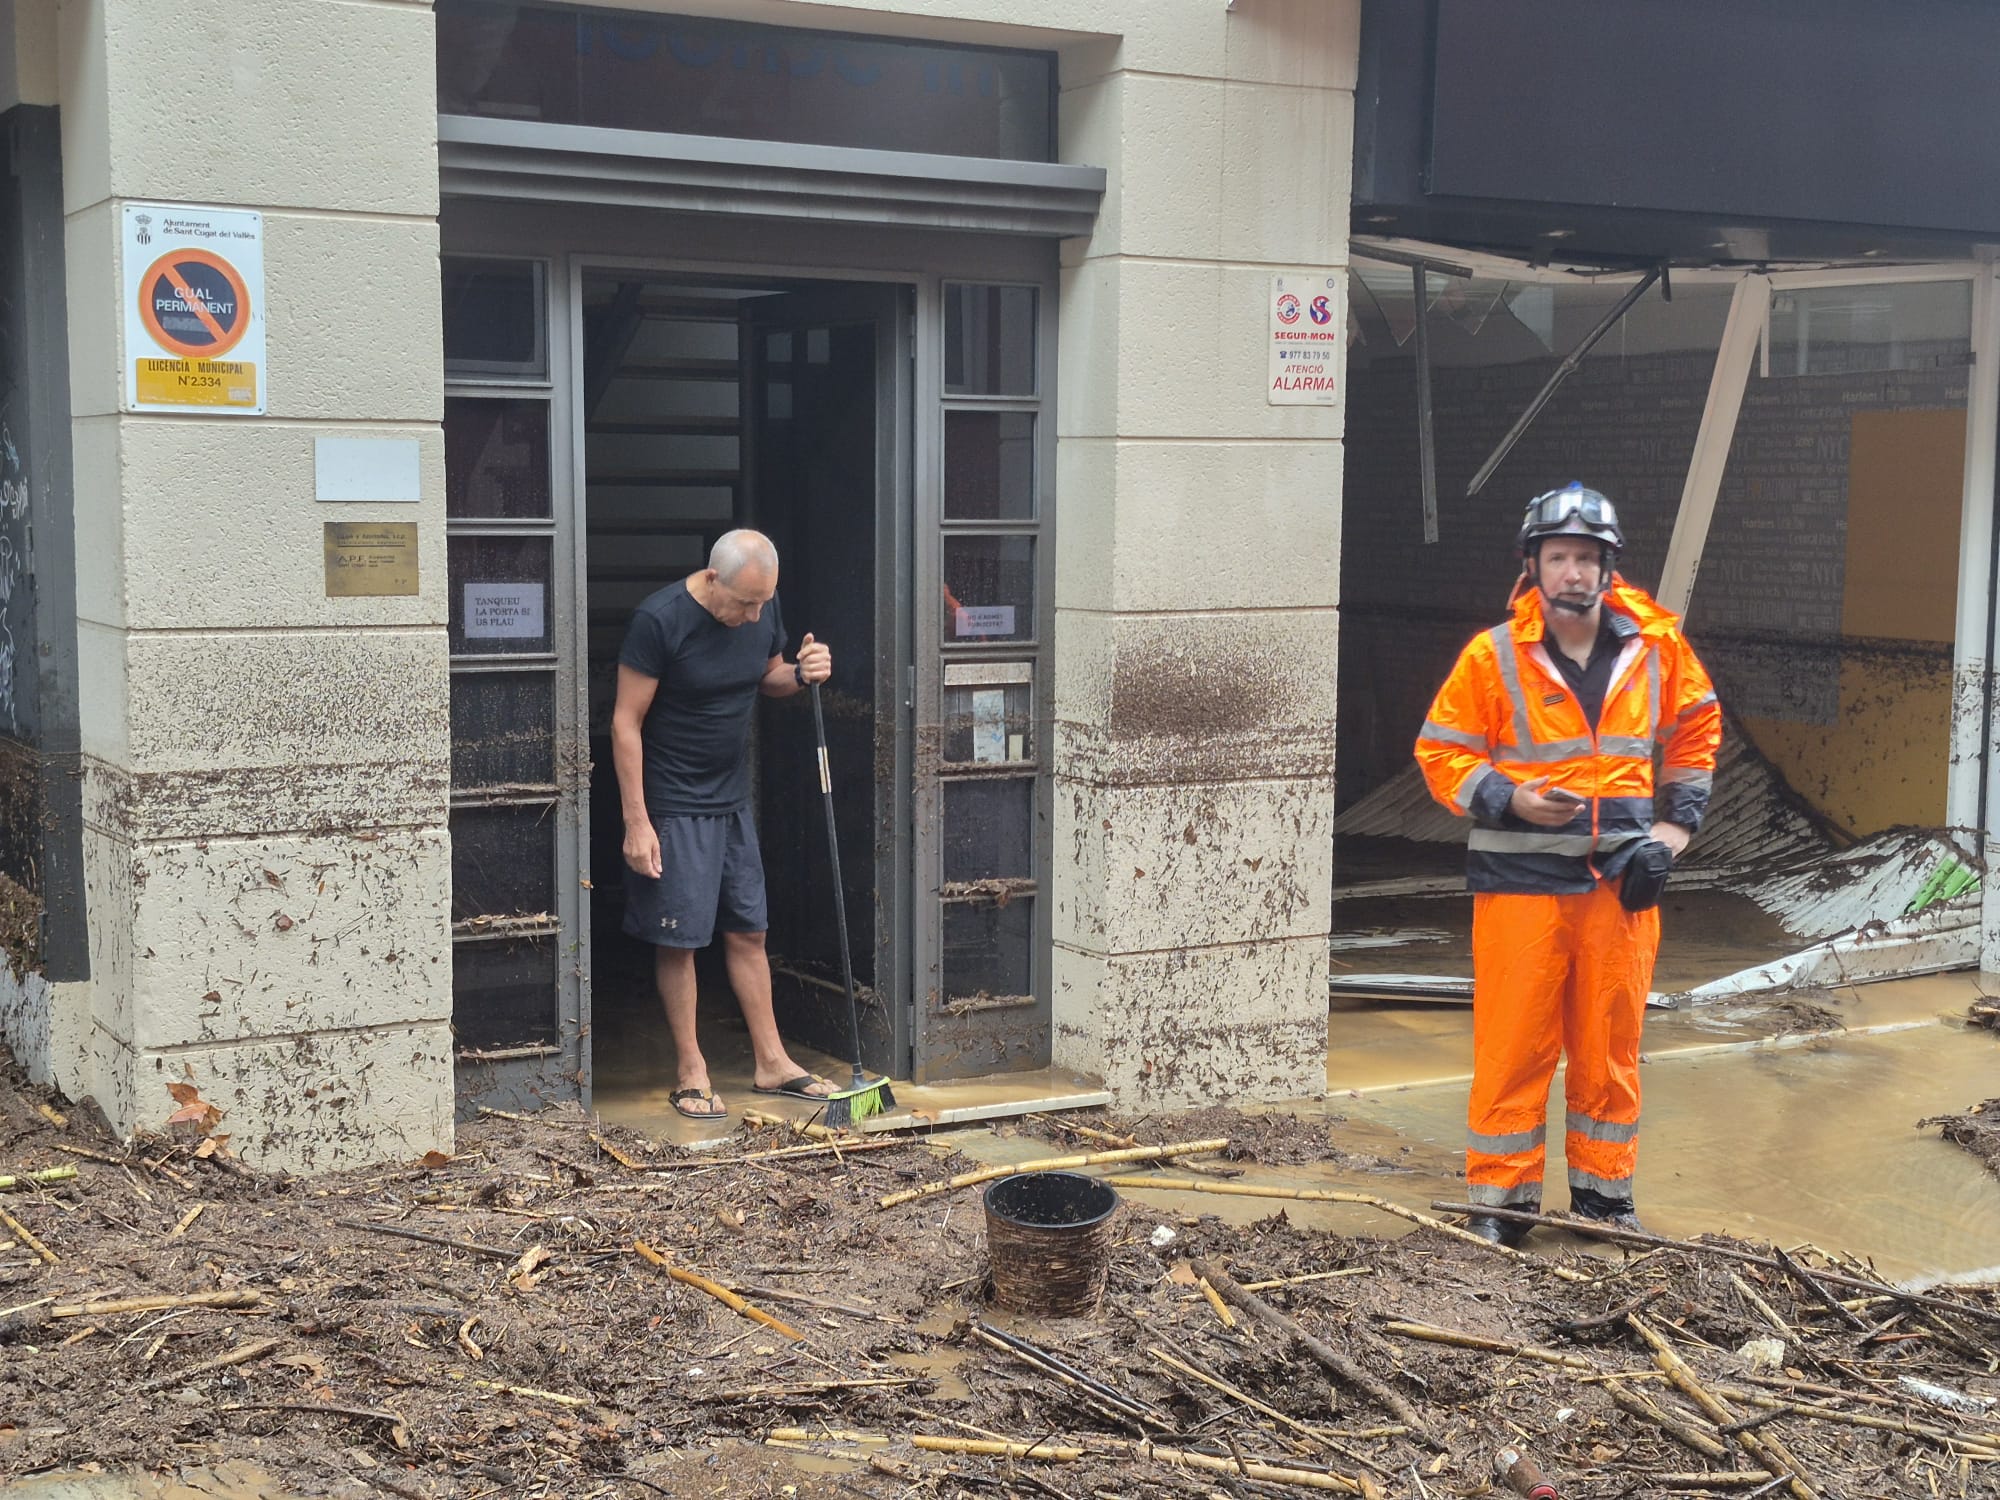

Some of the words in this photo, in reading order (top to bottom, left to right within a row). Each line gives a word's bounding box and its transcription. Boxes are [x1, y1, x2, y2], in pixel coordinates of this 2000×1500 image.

[163, 218, 210, 228] Ajuntament
[174, 227, 193, 235] Sant
[194, 229, 217, 238] Cugat
[218, 230, 231, 238] del
[174, 287, 213, 300] GUAL
[156, 299, 234, 314] PERMANENT
[198, 361, 243, 374] MUNICIPAL
[1273, 376, 1334, 391] ALARMA
[475, 598, 520, 607] TANQUEU
[475, 608, 487, 617] LA
[489, 608, 519, 617] PORTA
[521, 608, 531, 616] SI
[475, 618, 488, 627] US
[490, 618, 514, 627] PLAU
